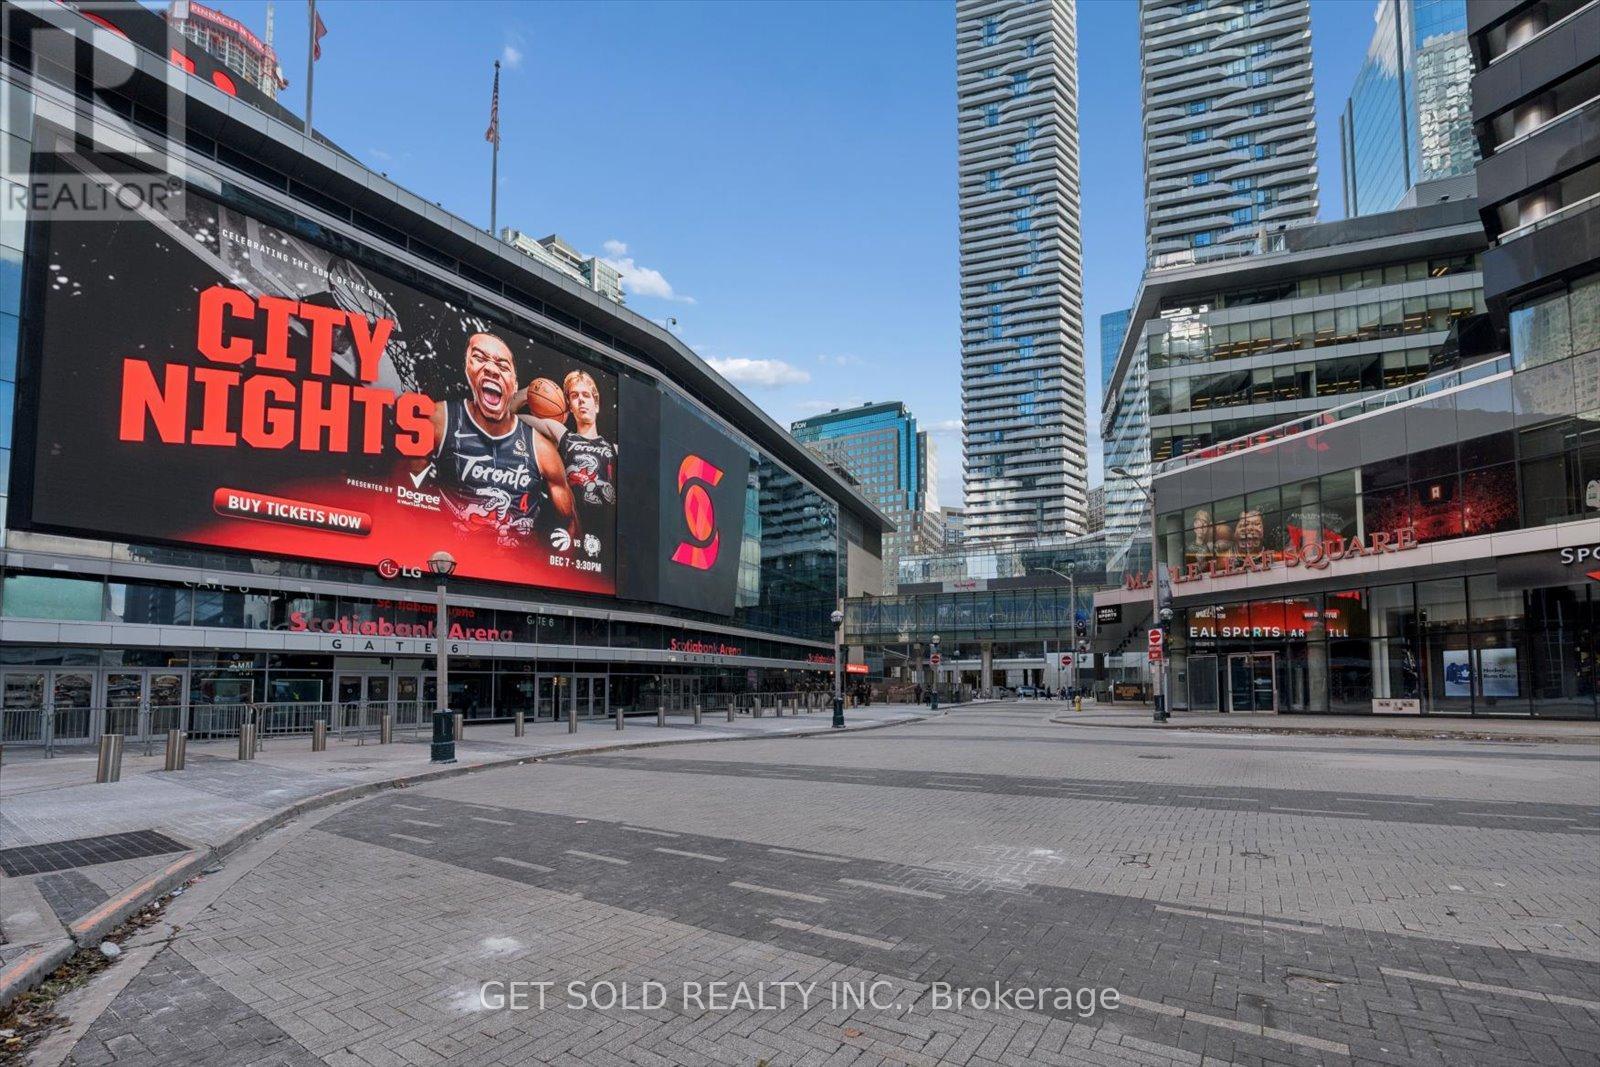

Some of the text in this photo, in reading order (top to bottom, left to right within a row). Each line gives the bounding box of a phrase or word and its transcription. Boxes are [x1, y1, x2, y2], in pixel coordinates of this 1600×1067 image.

[222, 229, 288, 262] CELEBRATING
[292, 257, 309, 271] THE
[312, 265, 334, 282] SOUL
[337, 276, 347, 286] OF
[350, 280, 365, 294] THE
[198, 285, 395, 382] CITY
[120, 358, 436, 457] NIGHTS
[566, 439, 613, 458] Toronto
[453, 451, 531, 489] Toronto
[346, 478, 383, 492] PRESENTED
[397, 485, 440, 505] Degree
[228, 495, 362, 530] BUY TICKETS NOW
[520, 493, 529, 513] 4
[549, 555, 564, 567] DEC
[565, 557, 570, 568] 7
[1125, 526, 1418, 591] MALE LEAF SQUARE
[402, 565, 422, 578] LG
[448, 623, 514, 642] Arena
[671, 638, 718, 653] Scotiabank
